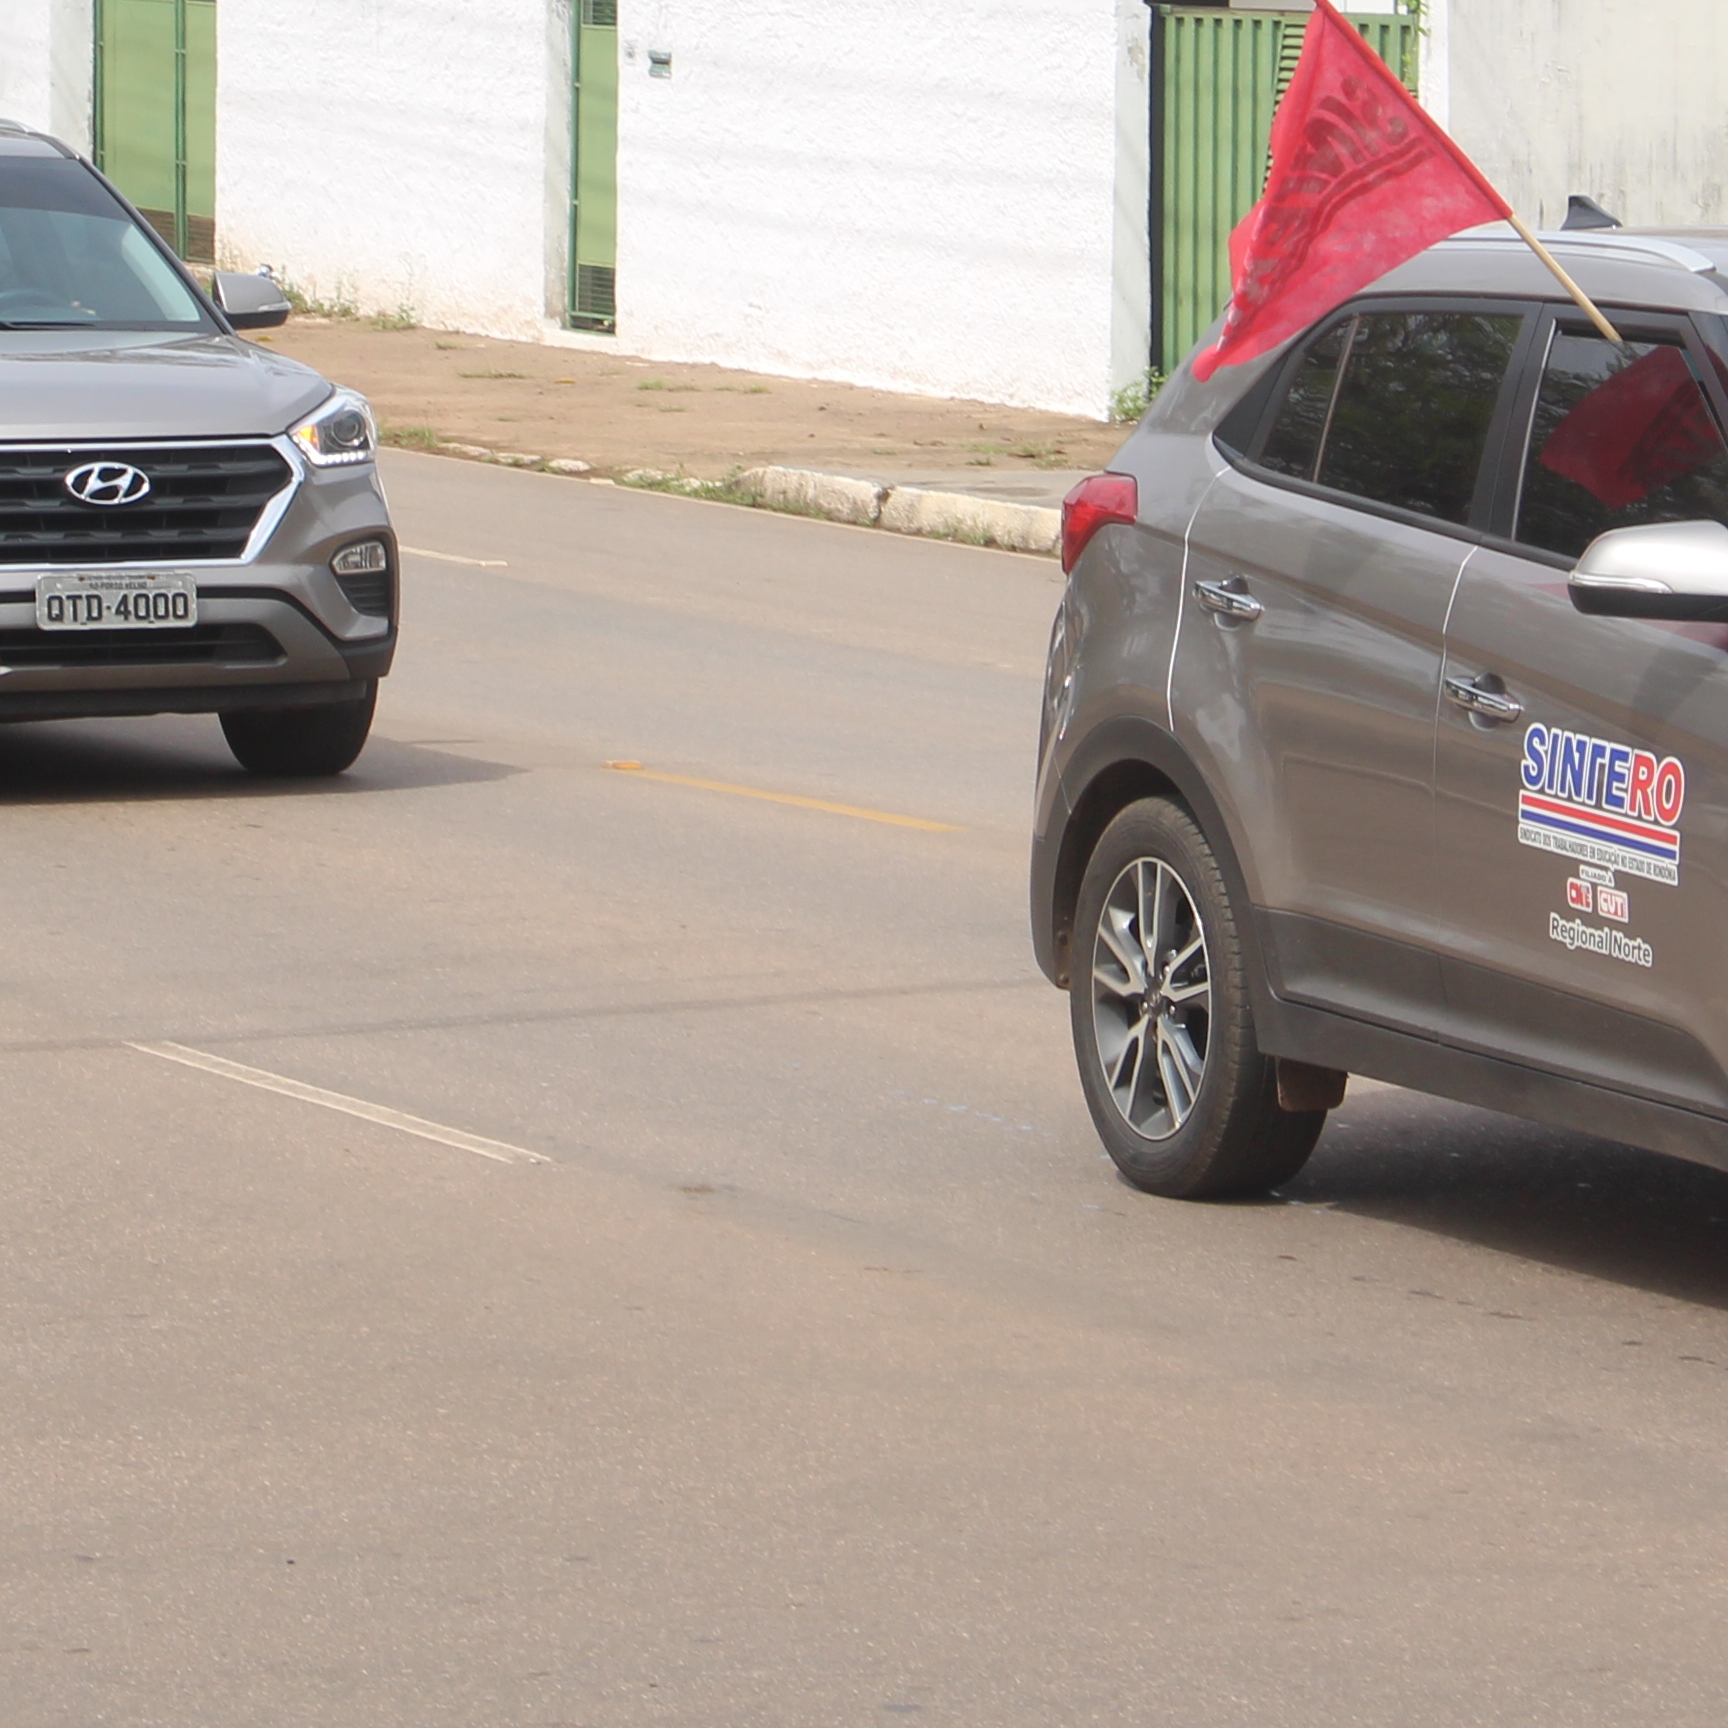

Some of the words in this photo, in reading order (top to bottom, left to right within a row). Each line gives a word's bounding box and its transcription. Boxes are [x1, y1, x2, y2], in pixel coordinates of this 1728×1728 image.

[1521, 724, 1684, 825] SINTERO
[1551, 915, 1609, 952] Regional
[1613, 933, 1652, 965] Norte
